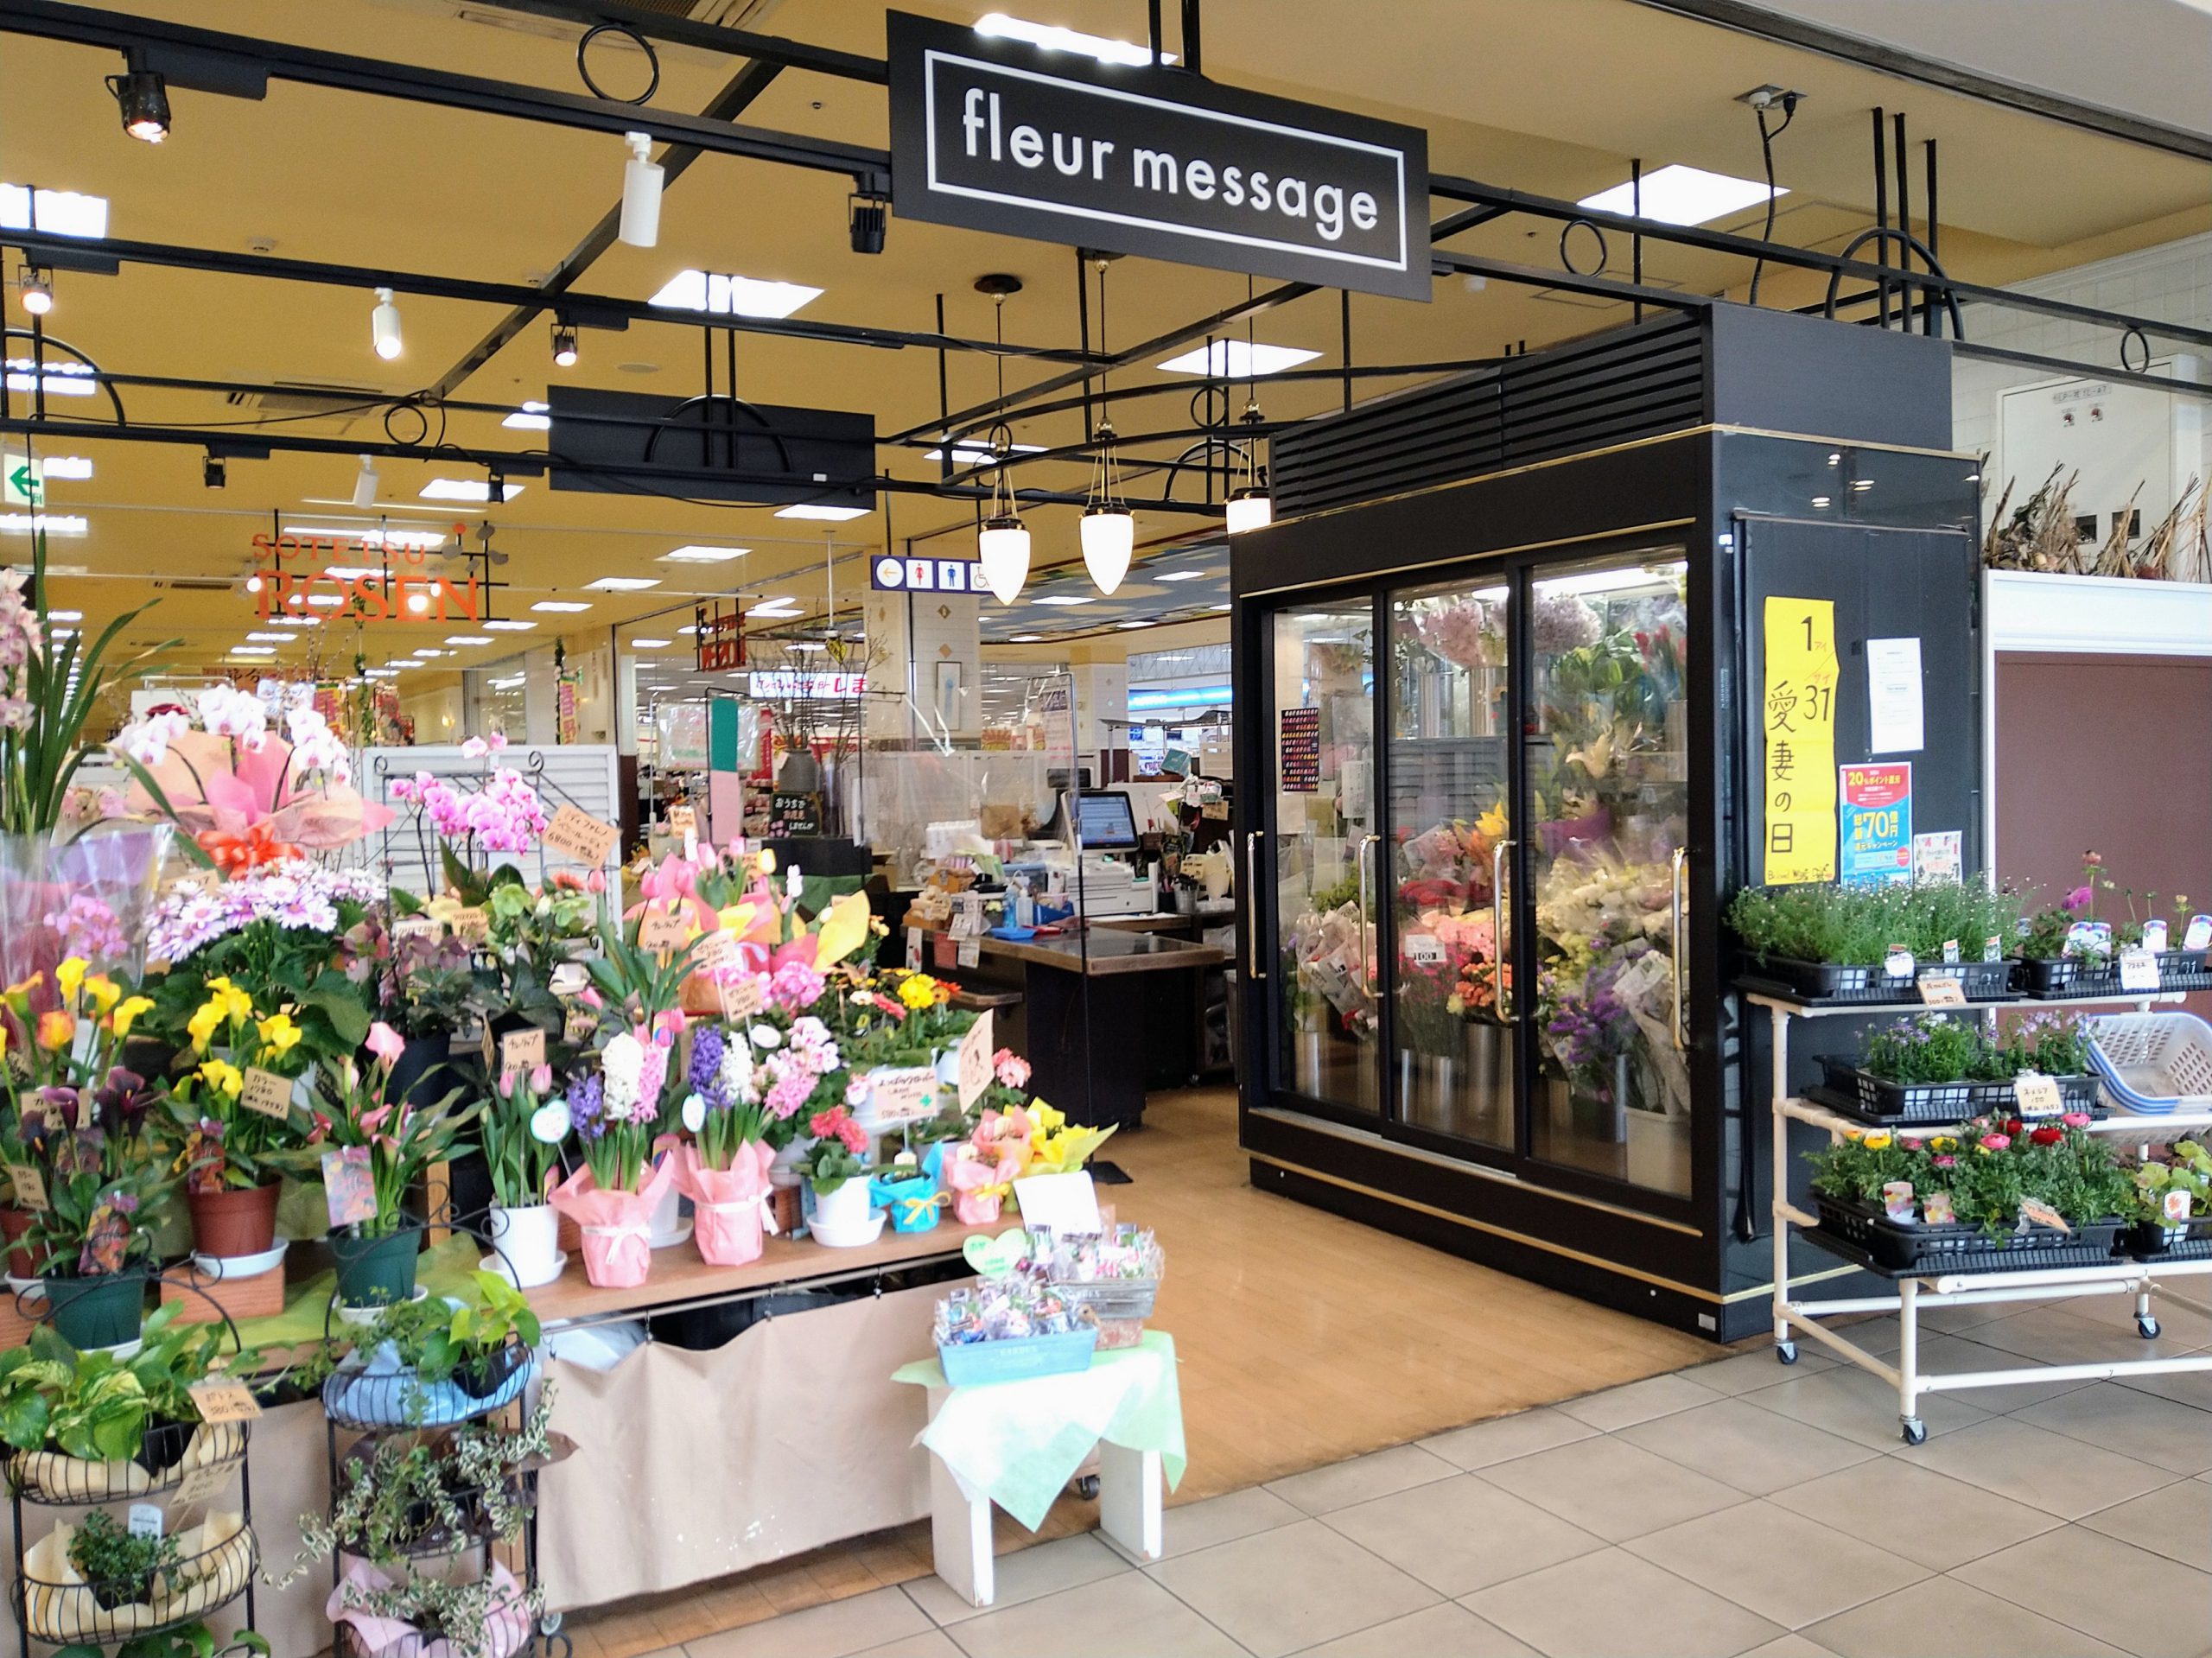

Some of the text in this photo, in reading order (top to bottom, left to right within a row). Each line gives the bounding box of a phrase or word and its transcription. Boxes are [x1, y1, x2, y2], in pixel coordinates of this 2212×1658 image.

[963, 87, 1377, 241] fleur message
[251, 533, 426, 565] SOTETSU
[257, 570, 478, 623] ROSEN
[1801, 616, 1812, 651] 1
[1803, 685, 1831, 721] 31
[1768, 680, 1797, 853] 愛妻の日
[253, 1074, 276, 1085] カラー
